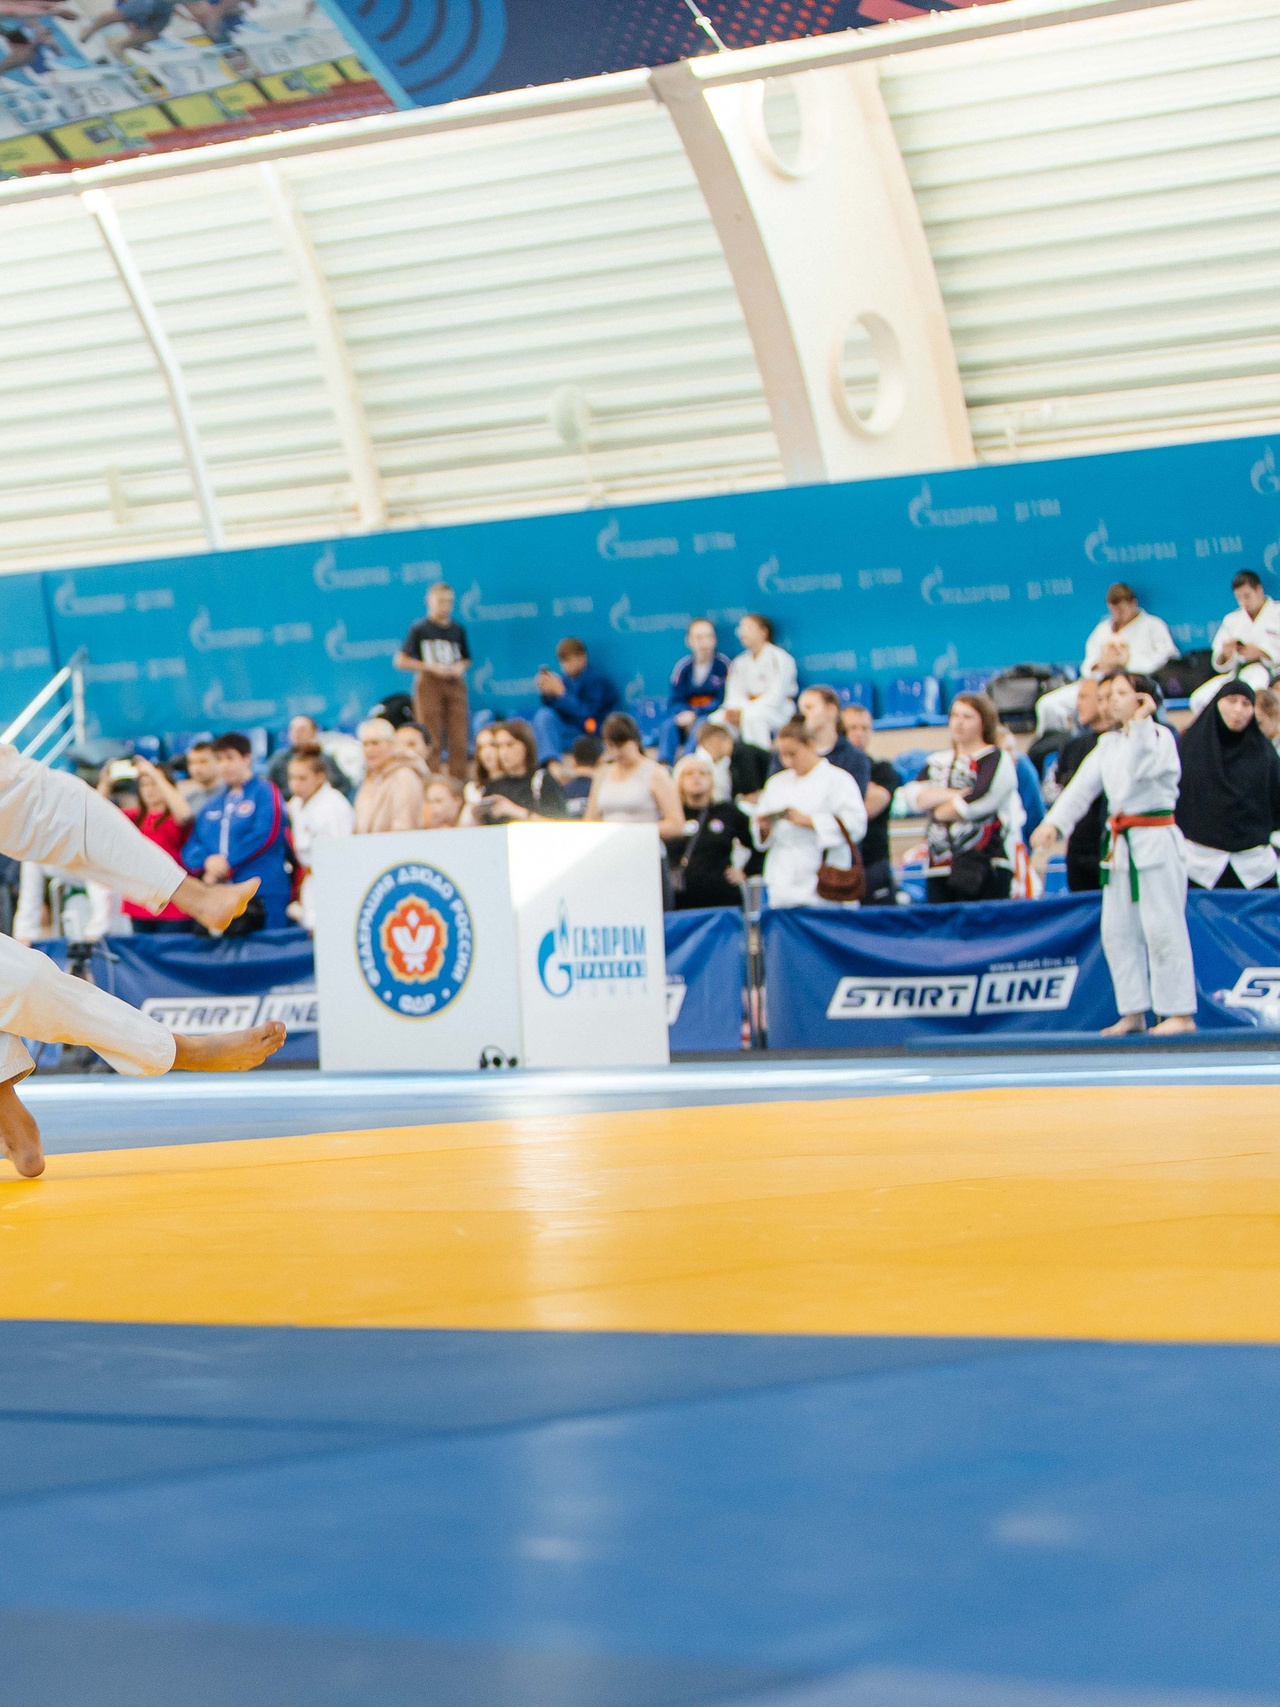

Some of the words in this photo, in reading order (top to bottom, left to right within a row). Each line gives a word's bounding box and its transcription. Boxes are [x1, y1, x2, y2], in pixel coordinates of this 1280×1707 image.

[573, 925, 646, 957] ГАЗПРОМ
[841, 985, 969, 1008] START
[985, 975, 1066, 1005] LINE
